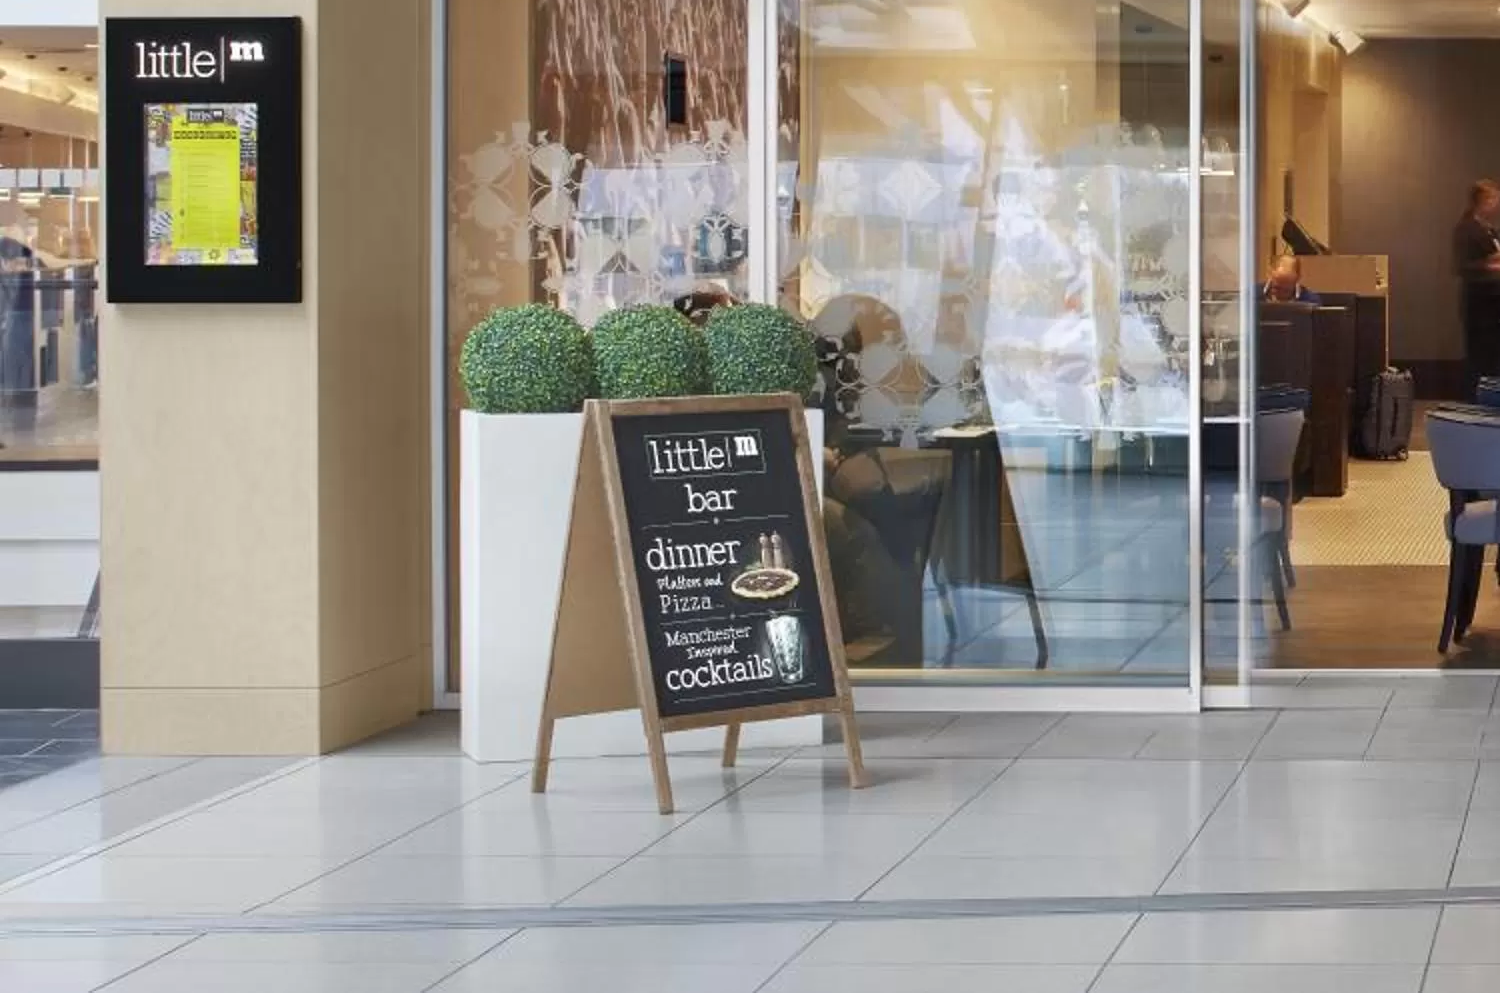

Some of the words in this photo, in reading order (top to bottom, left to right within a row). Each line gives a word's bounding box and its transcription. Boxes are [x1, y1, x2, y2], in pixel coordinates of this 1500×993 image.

[135, 41, 216, 79] little
[229, 40, 264, 61] m
[649, 437, 725, 474] little
[734, 435, 759, 457] m
[684, 483, 737, 513] bar
[646, 537, 741, 571] dinner
[664, 625, 752, 647] Manchester
[666, 654, 773, 690] cocktails
